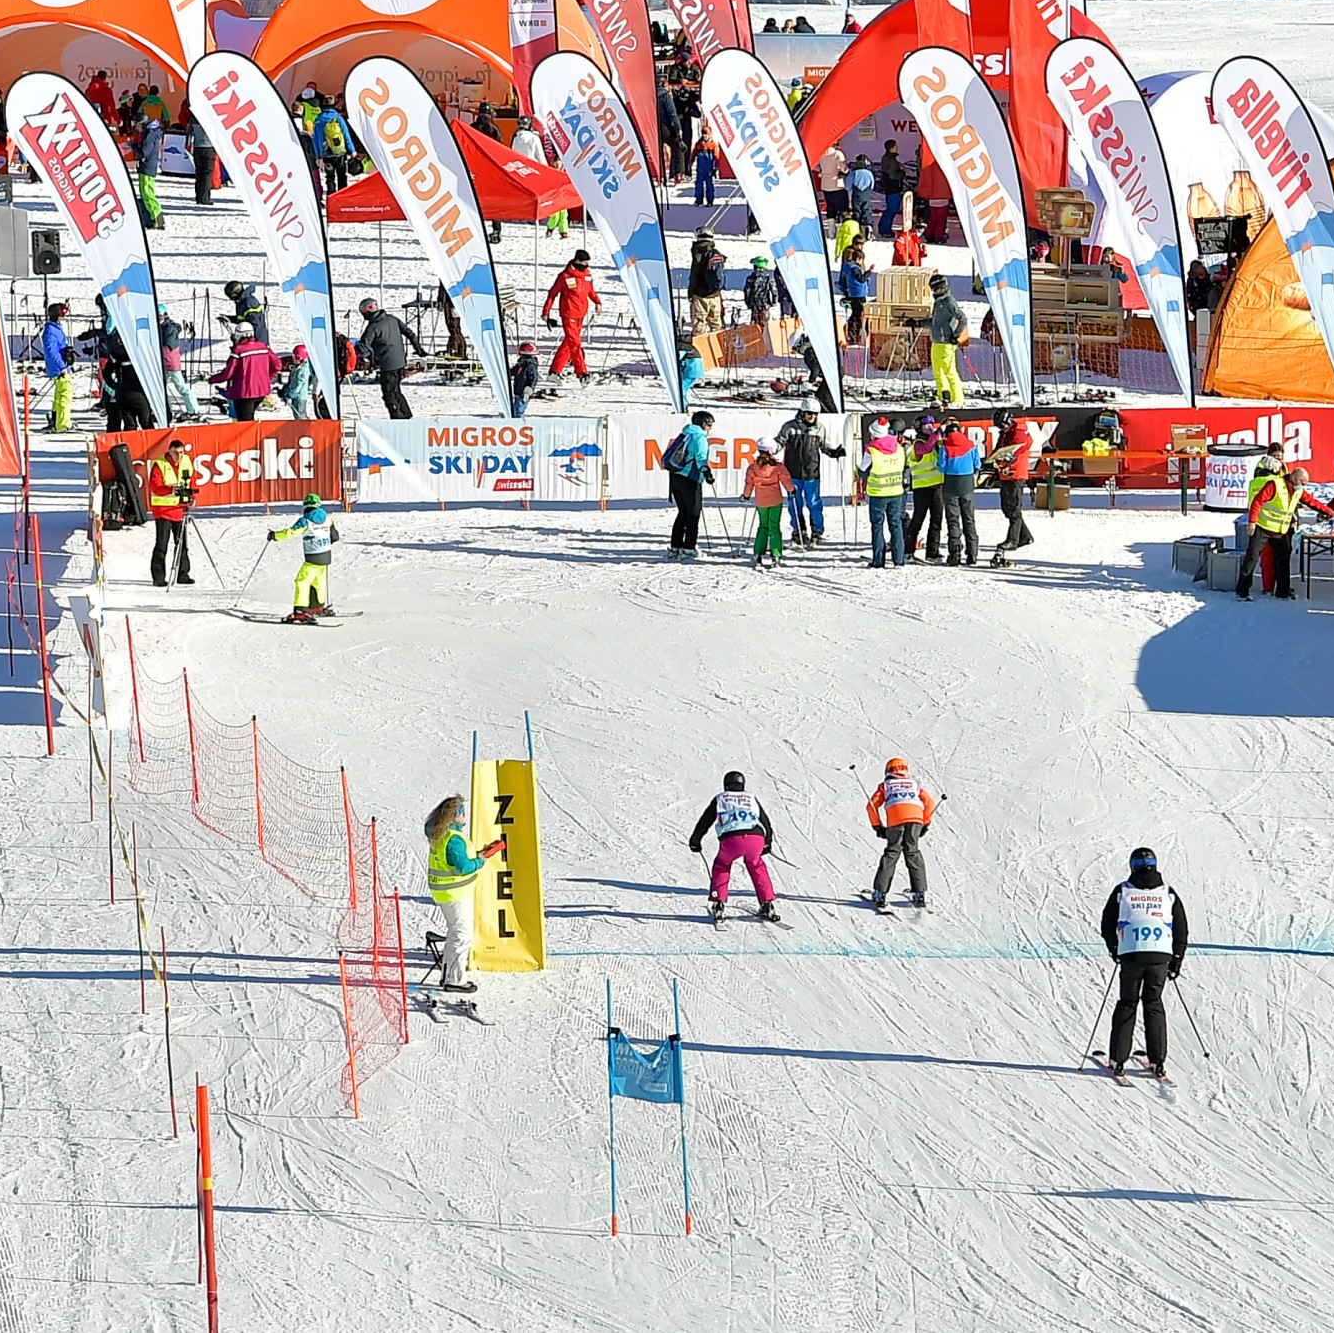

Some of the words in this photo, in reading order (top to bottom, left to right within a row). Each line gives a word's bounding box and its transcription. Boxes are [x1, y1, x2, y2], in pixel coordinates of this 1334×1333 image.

[427, 426, 534, 447] MIGROS
[429, 451, 473, 474] SKI
[481, 451, 533, 474] DAY
[644, 437, 759, 471] MGR
[496, 479, 533, 490] swissski
[1224, 478, 1247, 489] DAY
[493, 795, 515, 938] ZIEL
[1132, 926, 1163, 941] 199
